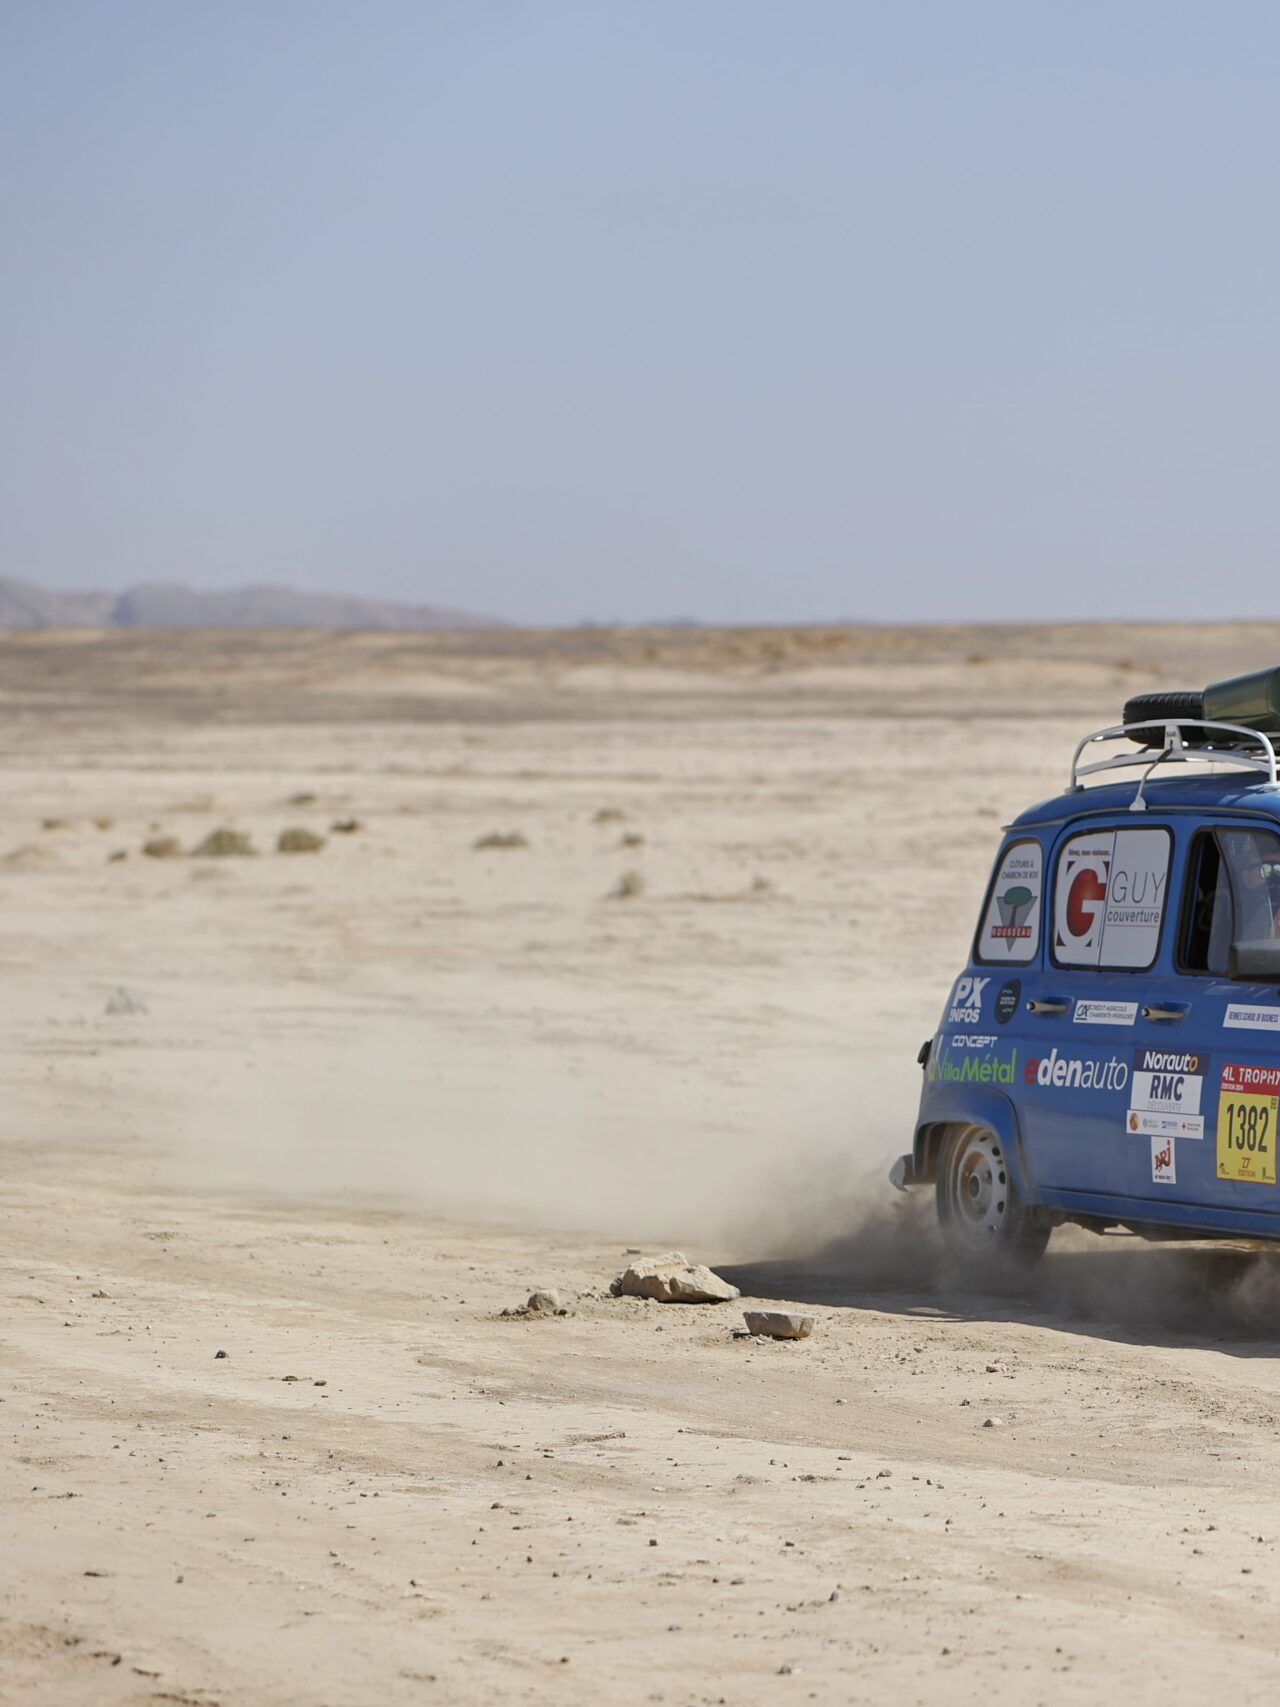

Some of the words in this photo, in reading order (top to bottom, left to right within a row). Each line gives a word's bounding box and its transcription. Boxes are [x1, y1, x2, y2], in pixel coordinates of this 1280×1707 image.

[1111, 871, 1166, 903] GUY
[1107, 909, 1159, 923] couverture
[991, 927, 1032, 937] ROUSSEAU
[952, 977, 991, 1008] PX
[949, 1008, 980, 1023] INFOS
[1242, 1012, 1256, 1021] SCHOOL
[952, 1035, 998, 1048] CONCEPT
[1024, 1048, 1129, 1090] edenauto
[1143, 1051, 1198, 1072] Norauto
[1222, 1066, 1235, 1081] 4L
[1150, 1075, 1184, 1101] RMC
[1226, 1103, 1269, 1152] 1382
